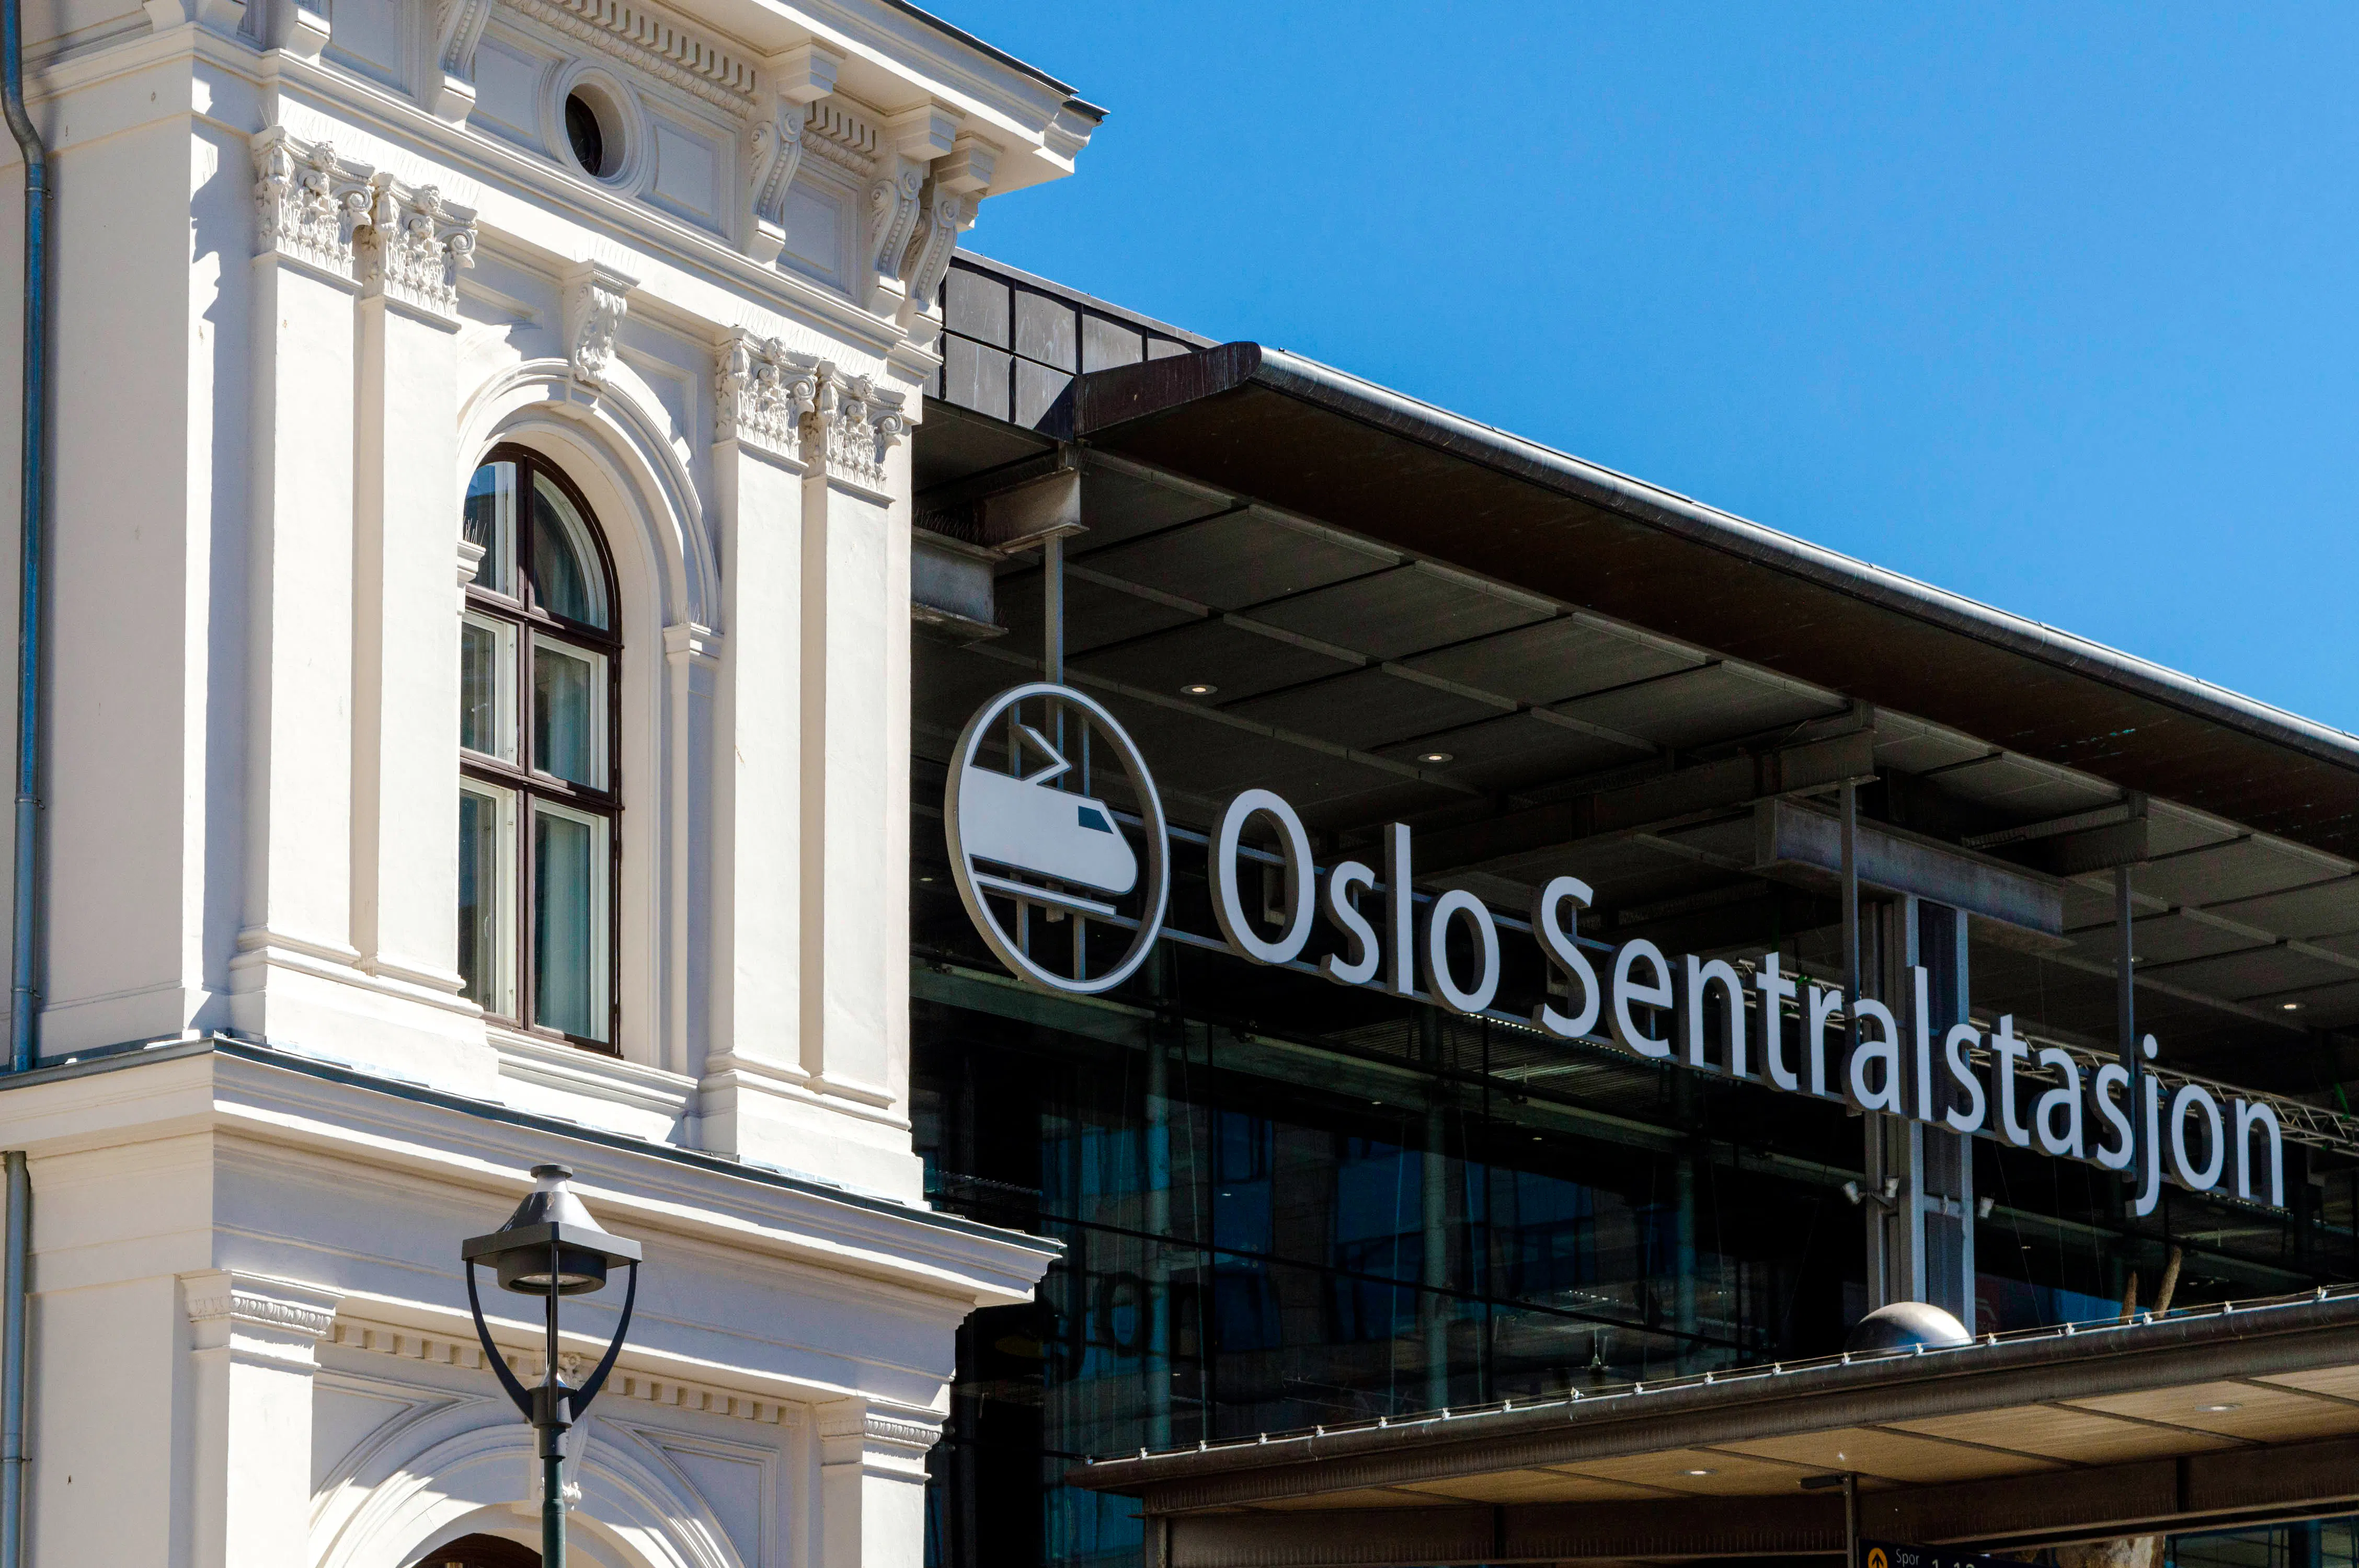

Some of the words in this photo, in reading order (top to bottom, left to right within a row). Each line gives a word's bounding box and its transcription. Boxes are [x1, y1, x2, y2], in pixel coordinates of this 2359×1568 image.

[1209, 788, 1501, 1014] Oslo
[1532, 875, 2285, 1217] Sentralstasjon
[1896, 1548, 1920, 1567] Spor
